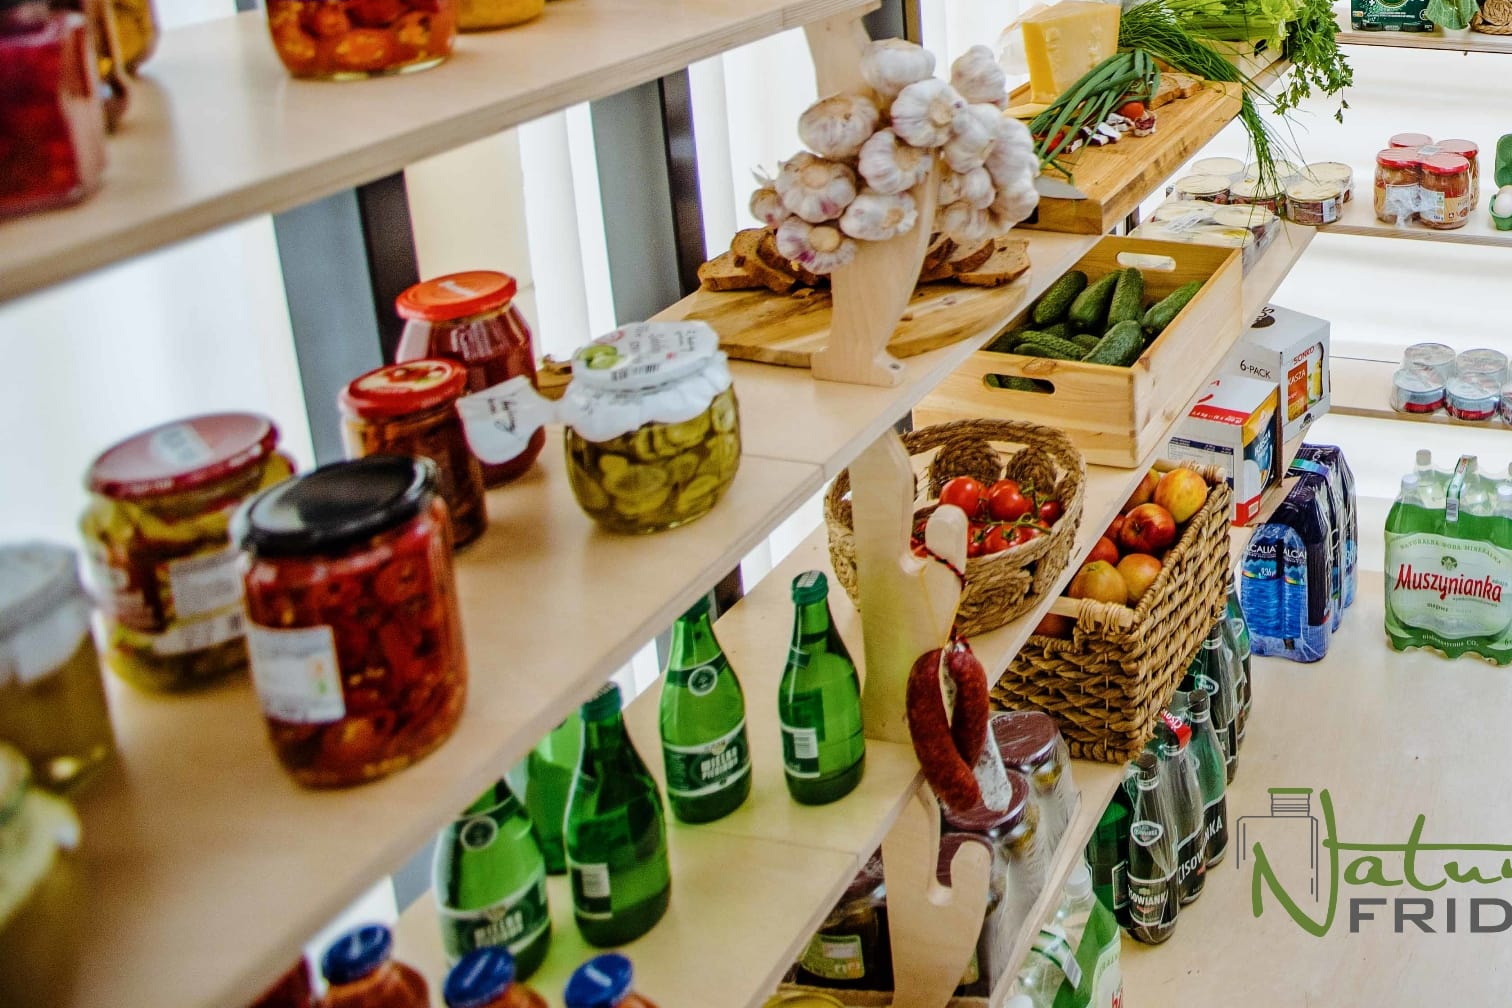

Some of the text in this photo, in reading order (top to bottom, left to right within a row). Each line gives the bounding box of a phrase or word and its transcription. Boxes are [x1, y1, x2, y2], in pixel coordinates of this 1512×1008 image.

[1293, 345, 1316, 365] SONKO
[1239, 359, 1272, 380] 6-PACK
[1245, 543, 1276, 554] CALIA
[1393, 563, 1502, 601] Muszynianka
